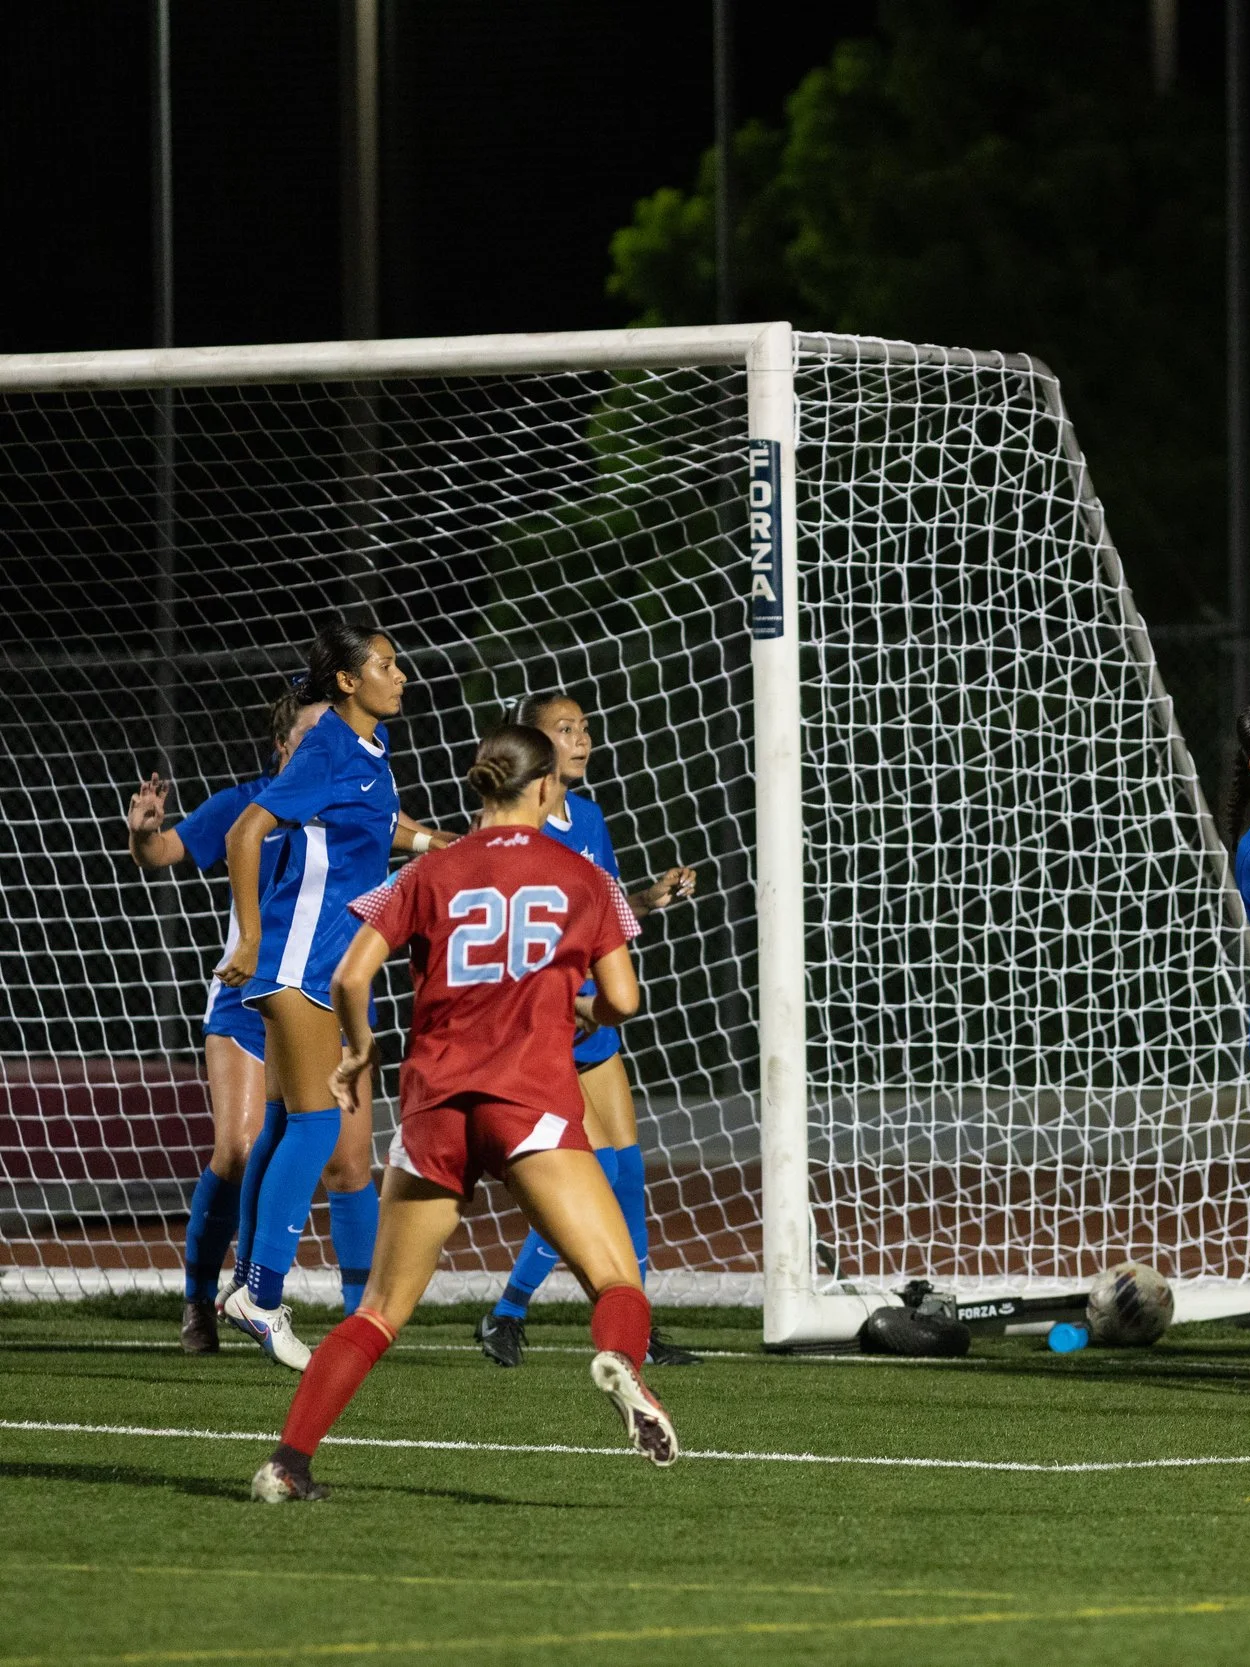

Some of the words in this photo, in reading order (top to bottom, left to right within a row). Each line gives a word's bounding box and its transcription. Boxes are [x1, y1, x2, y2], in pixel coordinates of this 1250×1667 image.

[750, 448, 777, 602] FORZA
[447, 885, 569, 988] 26
[957, 1304, 998, 1321] FORZA
